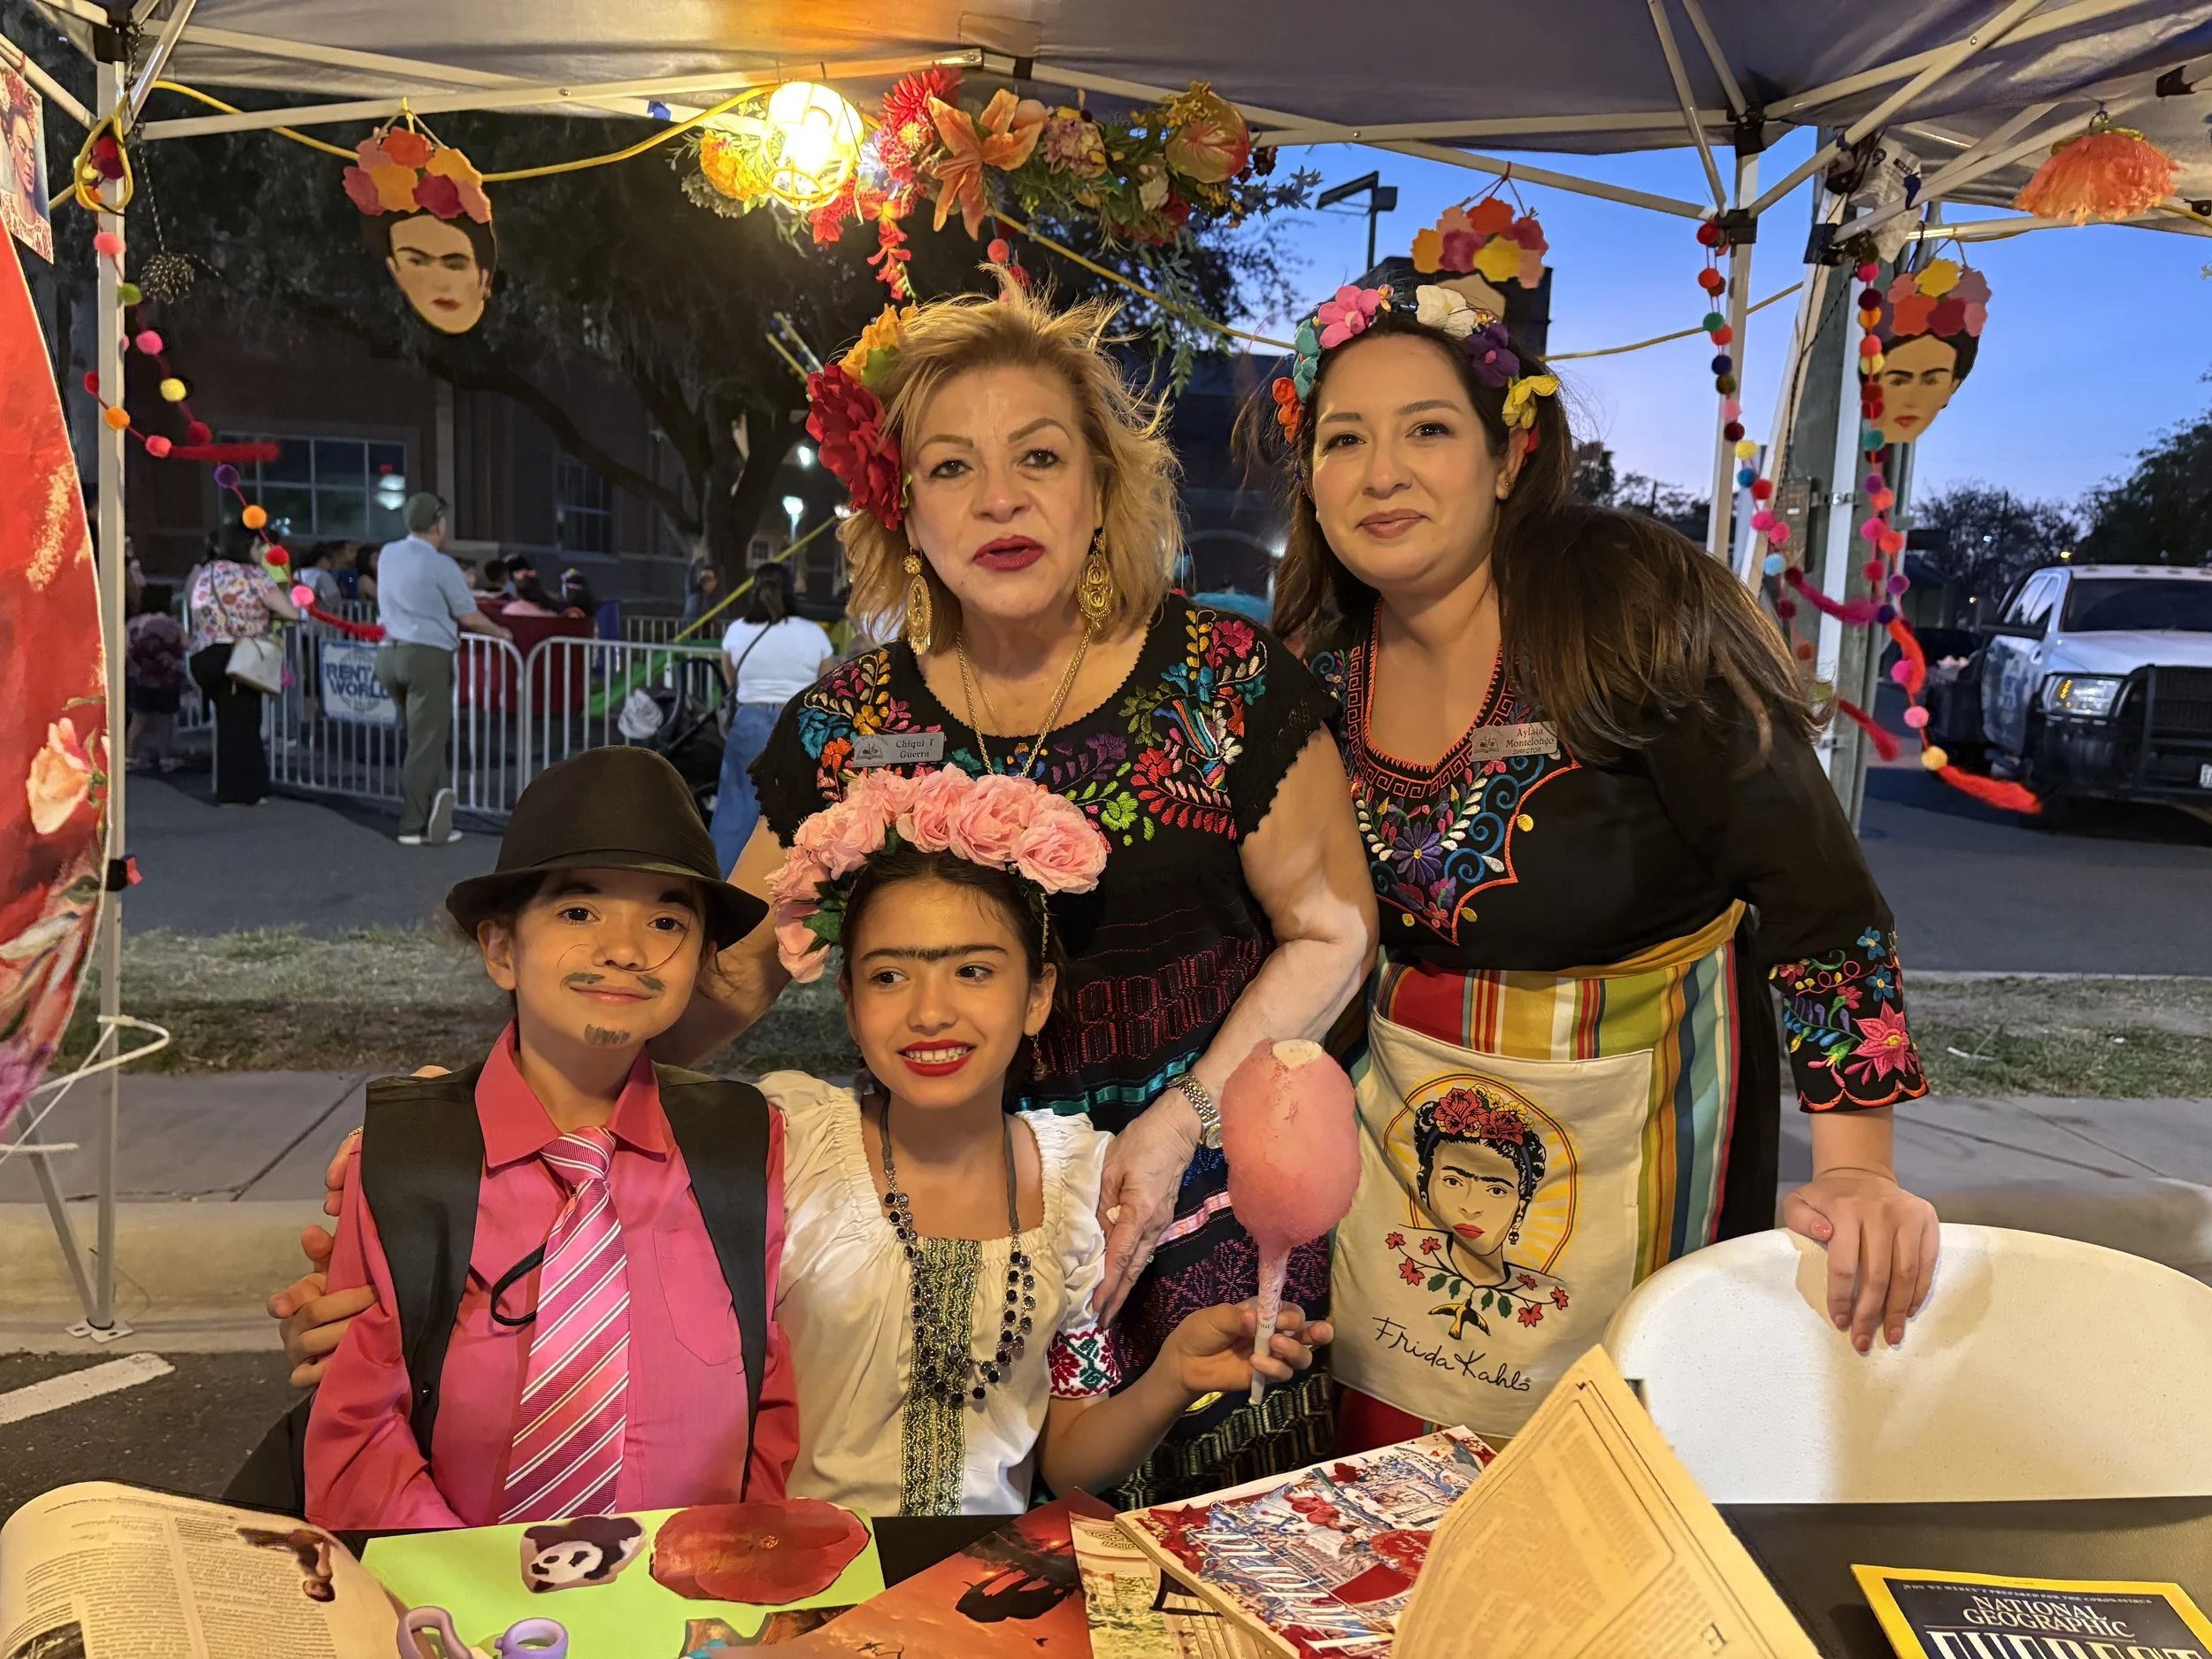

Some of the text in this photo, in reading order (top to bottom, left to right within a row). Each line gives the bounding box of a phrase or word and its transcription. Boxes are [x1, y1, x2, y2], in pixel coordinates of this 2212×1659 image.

[326, 663, 377, 683] RENT
[1372, 1317, 1455, 1371] Frida
[1972, 1595, 2108, 1621] NATIONAL
[1962, 1609, 2136, 1638] GEOGRAPHIC
